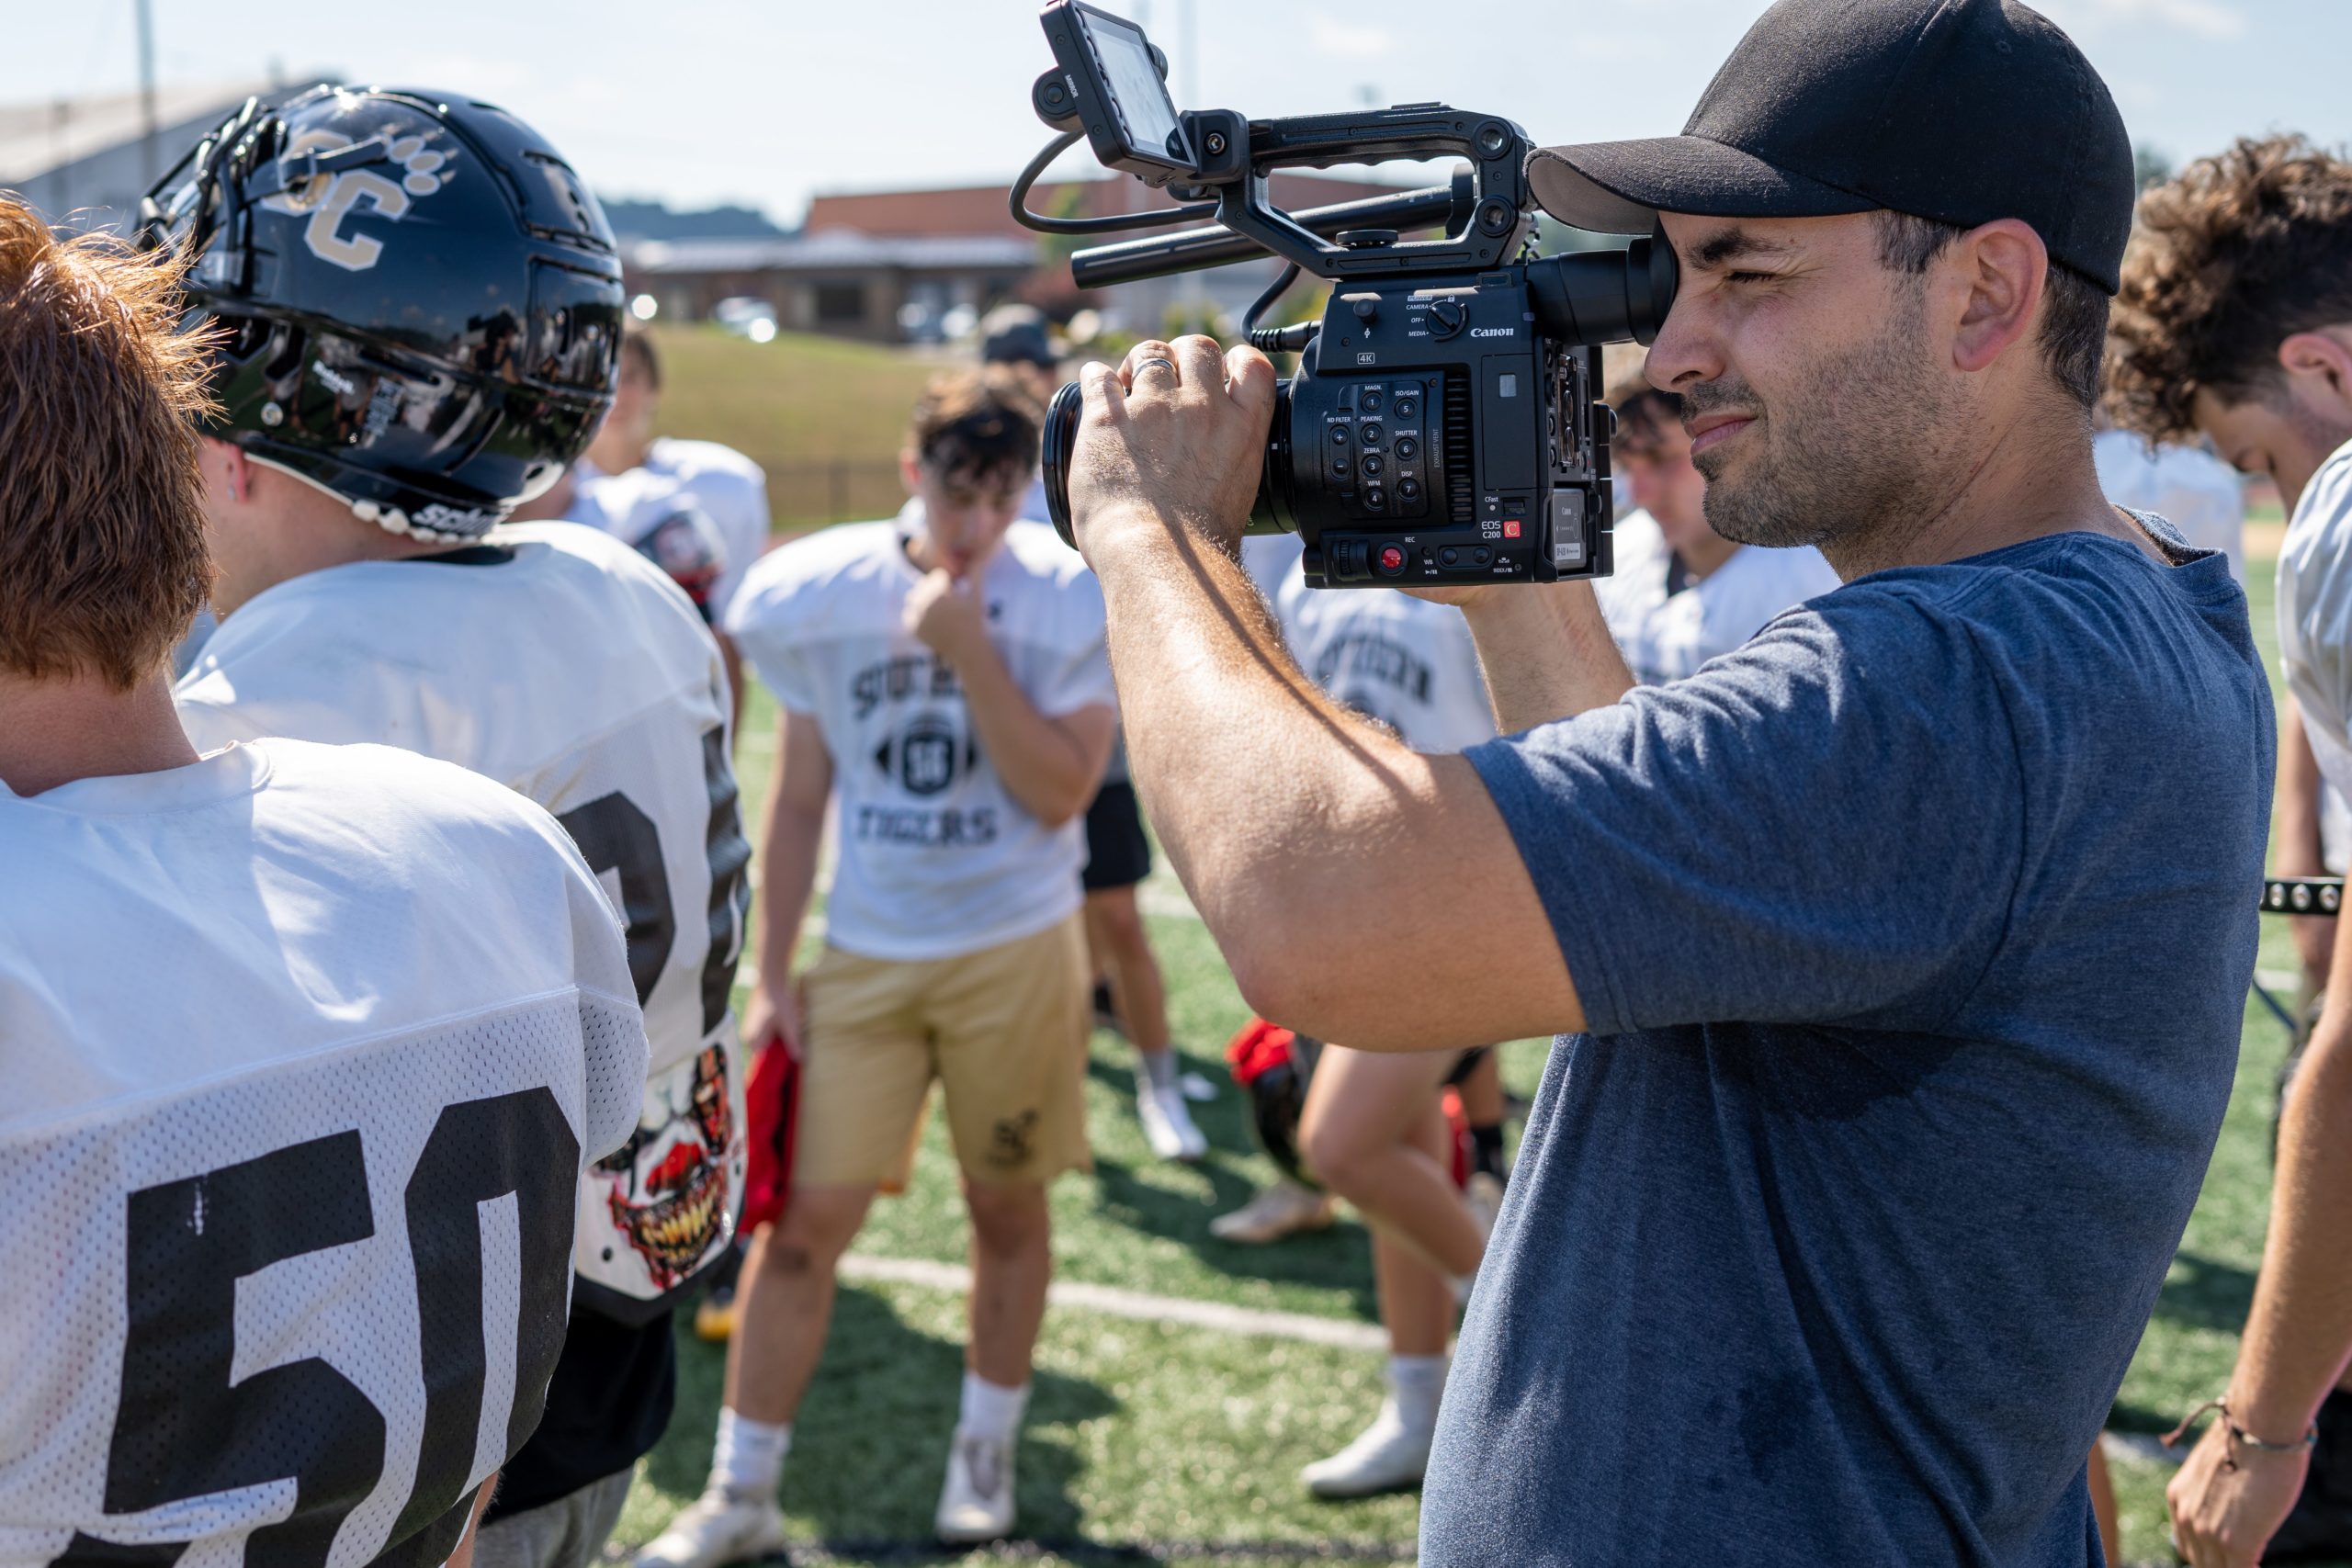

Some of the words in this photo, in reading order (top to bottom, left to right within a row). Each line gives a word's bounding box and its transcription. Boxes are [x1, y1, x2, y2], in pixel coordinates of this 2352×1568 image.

[1065, 74, 1079, 98] MIRROR
[1470, 327, 1514, 338] Canon
[1360, 354, 1373, 363] 4K
[1369, 430, 1374, 438] 2
[1370, 462, 1375, 470] 3
[1481, 521, 1501, 530] EOS
[1482, 531, 1501, 539] C200
[46, 1086, 582, 1568] 50
